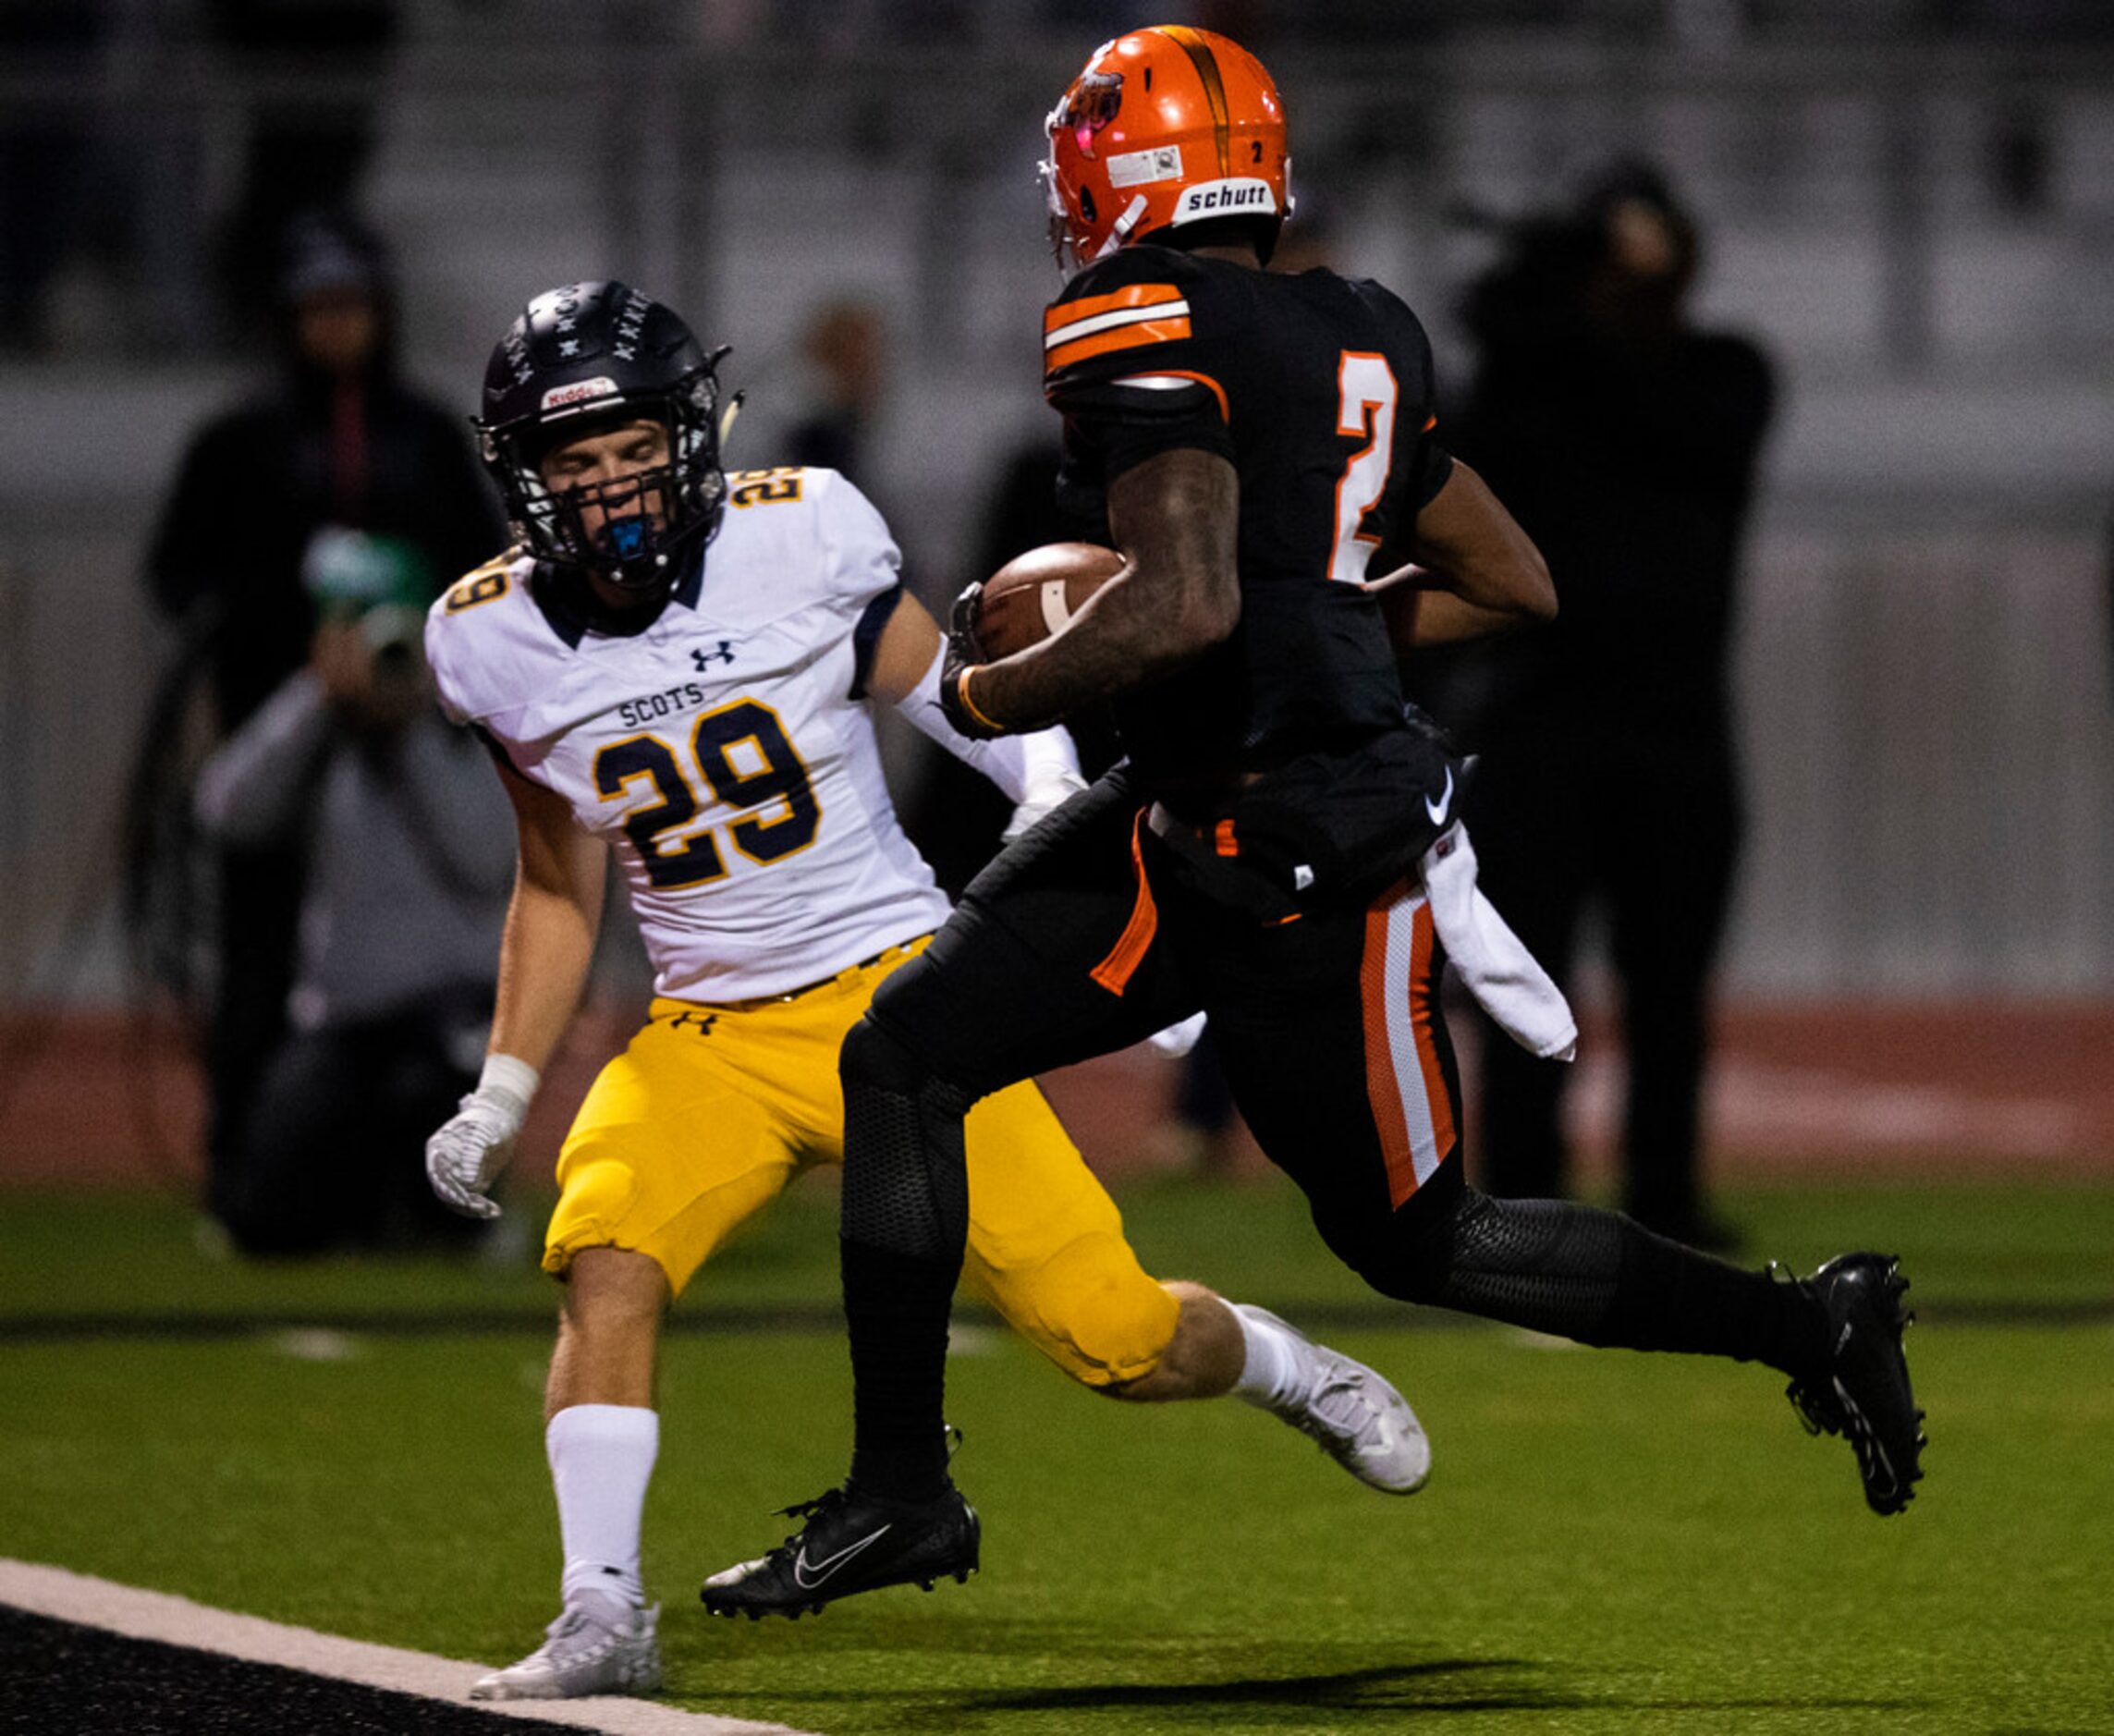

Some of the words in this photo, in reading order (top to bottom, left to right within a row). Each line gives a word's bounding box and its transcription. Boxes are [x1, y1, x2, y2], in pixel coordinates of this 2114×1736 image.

[1251, 141, 1263, 164] 2
[1189, 185, 1266, 211] schutt
[1326, 348, 1399, 590] 2
[619, 682, 704, 727] SCOTS
[592, 695, 824, 891] 29
